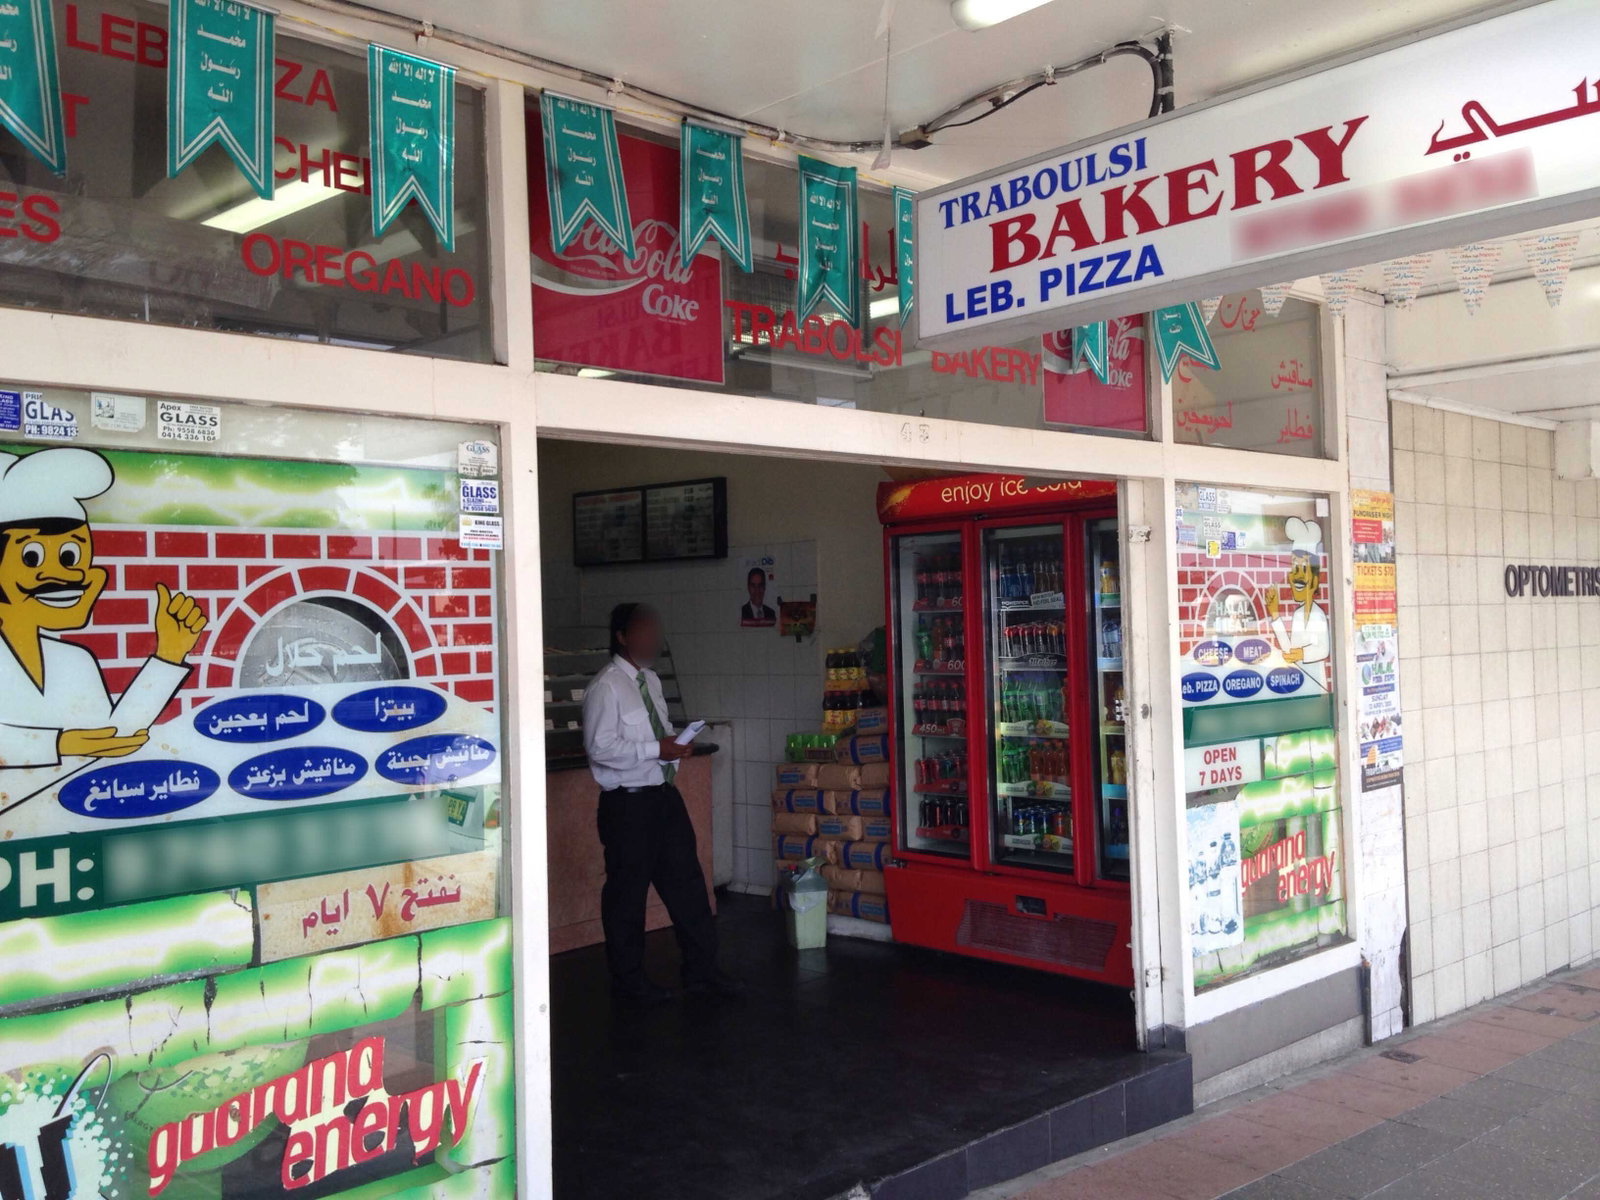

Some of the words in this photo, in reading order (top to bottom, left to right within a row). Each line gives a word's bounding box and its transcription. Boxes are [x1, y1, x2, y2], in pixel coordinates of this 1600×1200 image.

[939, 137, 1148, 230] TRABOULSI
[988, 115, 1369, 273] BAKERY
[241, 232, 476, 308] OREGANO
[946, 279, 1025, 324] LEB.
[1040, 244, 1165, 302] PIZZA
[642, 284, 699, 321] Coke
[724, 299, 903, 367] TRABOLSI
[931, 345, 1042, 387] BAKERY
[1109, 368, 1133, 387] oke
[160, 403, 182, 411] Apex
[160, 412, 218, 427] GLASS
[466, 444, 490, 453] GLASS
[462, 486, 497, 499] GLASS
[941, 481, 993, 504] enjoy
[1000, 476, 1029, 497] ice
[1356, 565, 1382, 577] TICKETS
[1215, 601, 1251, 616] HALAL
[1198, 648, 1229, 659] CHEESE
[1243, 646, 1262, 658] MEAT
[1196, 678, 1218, 692] PIZZA
[1226, 677, 1260, 691] OREGANO
[1270, 673, 1300, 687] SPINACH
[275, 701, 309, 731] لحم
[374, 697, 415, 722] بيتزا
[209, 712, 267, 735] بعجين
[386, 750, 431, 773] بجبنة
[434, 744, 490, 769] مناقيش
[1203, 747, 1237, 765] OPEN
[243, 764, 287, 791] بزعتر
[292, 757, 356, 785] مناقيش
[1199, 771, 1206, 786] 7
[1210, 766, 1242, 785] DAYS
[148, 769, 200, 801] فطاير
[1241, 829, 1306, 897] guarana
[1277, 851, 1335, 903] energy
[401, 873, 462, 922] نفتح
[148, 1036, 386, 1198] guarana
[282, 1061, 484, 1191] energy
